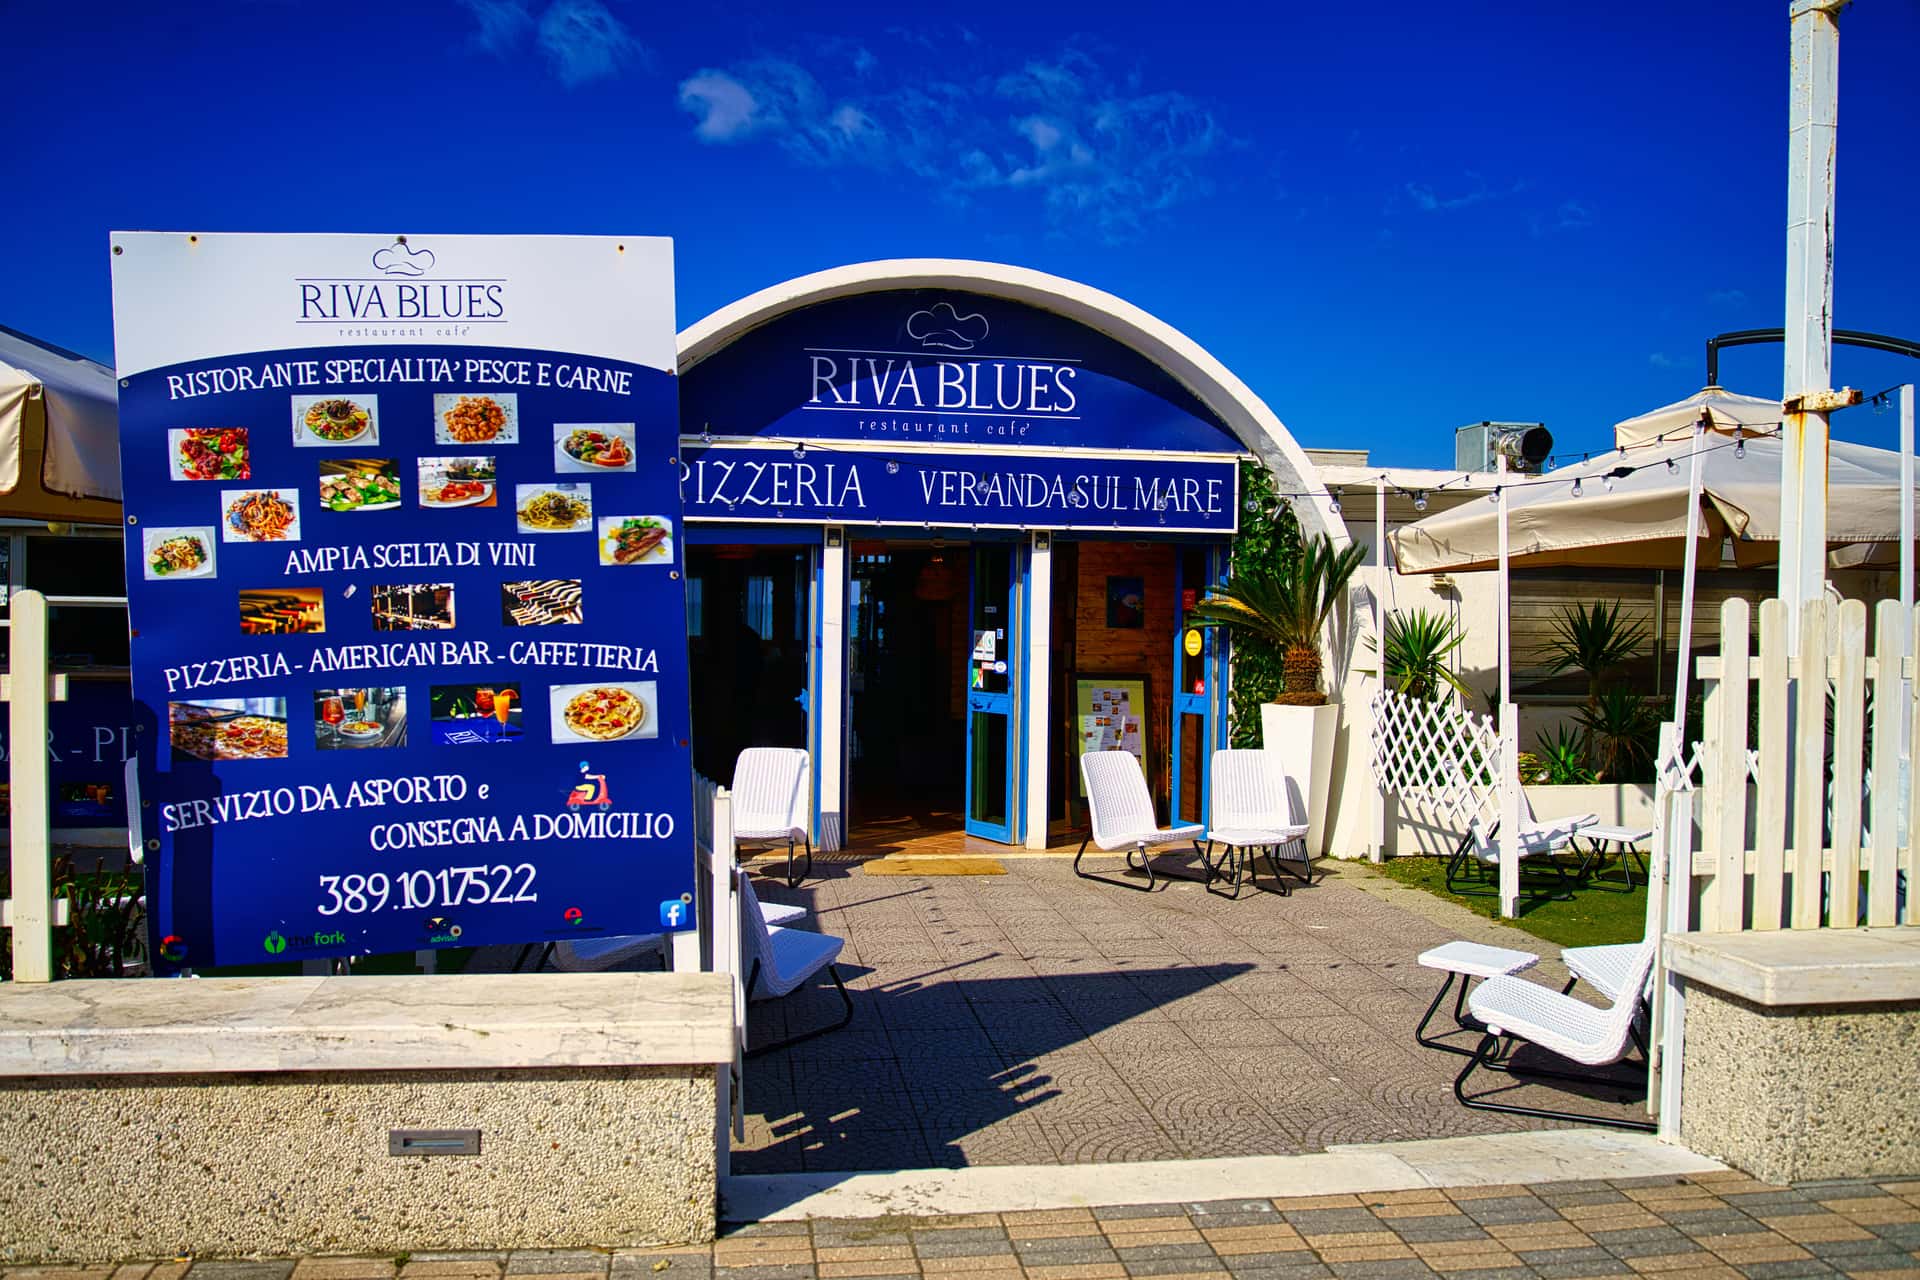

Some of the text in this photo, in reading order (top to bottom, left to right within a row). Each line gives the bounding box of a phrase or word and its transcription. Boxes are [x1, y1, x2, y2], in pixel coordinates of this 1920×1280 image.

[299, 284, 504, 319] RIVA BLUES
[339, 327, 423, 337] restaurant
[166, 358, 633, 401] RISTORANTE SPECIALITA' PESCE E CARNE
[808, 356, 1077, 413] RIVA BLUES
[859, 419, 969, 434] restaurant
[918, 470, 1068, 509] VERANDA
[1070, 475, 1128, 510] SUL
[1133, 476, 1223, 513] MARE
[284, 542, 536, 575] AMPIA SCELTA DI VINI
[163, 652, 292, 693] PIZZERIA
[308, 641, 436, 673] AMERICAN
[441, 640, 494, 666] BAR
[509, 641, 660, 673] CAFFETTERIA
[162, 774, 490, 833] SERVIZIO DA ASPORTO e
[369, 812, 674, 851] CONSEGNA A DOMICILIO
[317, 863, 538, 916] 389.1017522
